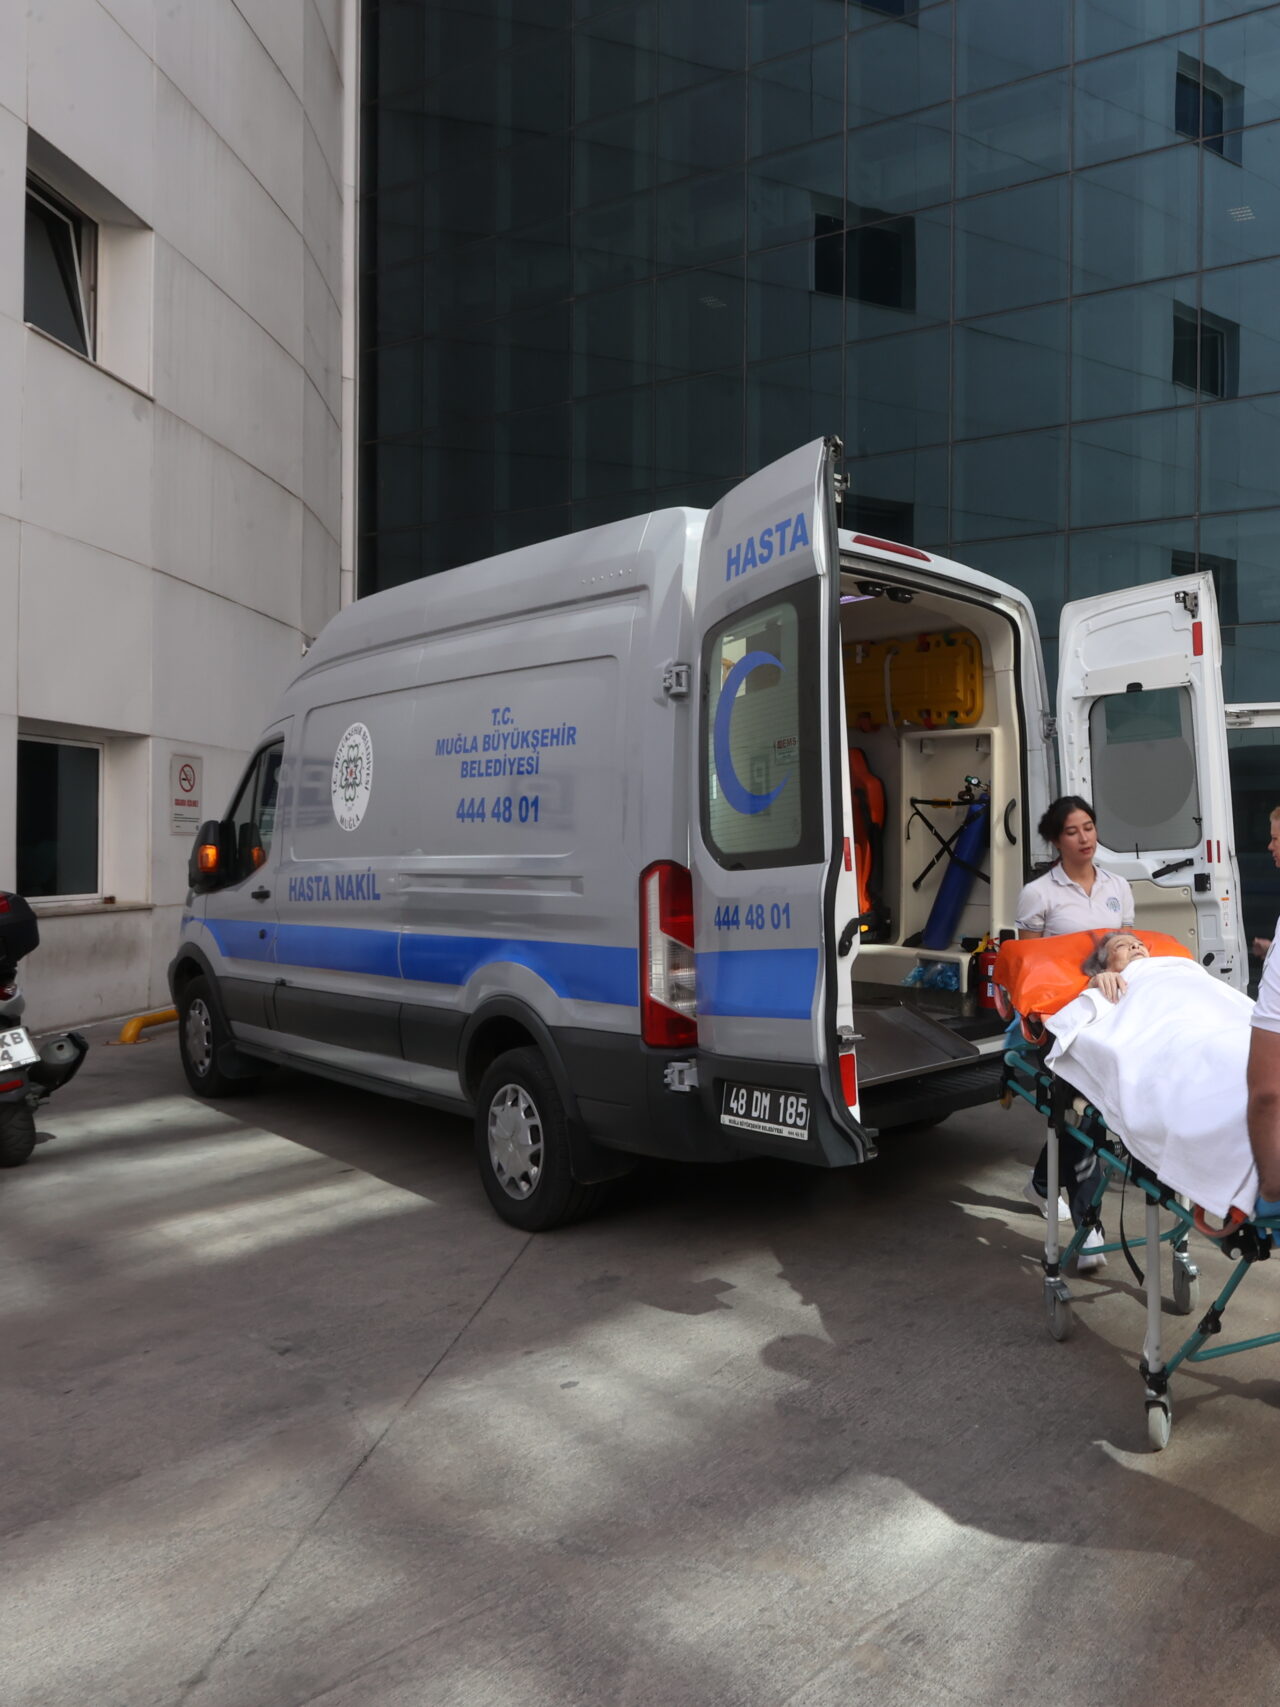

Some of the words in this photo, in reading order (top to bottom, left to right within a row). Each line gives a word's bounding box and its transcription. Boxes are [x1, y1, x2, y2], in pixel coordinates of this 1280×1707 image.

[726, 512, 809, 582] HASTA
[491, 707, 514, 726] T.C.
[435, 733, 478, 756] MUĞLA
[482, 722, 577, 753] BÜYÜKŞEHİR
[460, 751, 540, 778] BELEDİYESİ
[456, 797, 486, 823] 444
[491, 796, 513, 823] 48
[518, 795, 540, 823] 01
[289, 875, 331, 902] HASTA
[336, 866, 381, 901] NAKİL
[714, 904, 740, 931] 444
[745, 904, 765, 930] 48
[770, 902, 791, 929] 01
[729, 1087, 747, 1115] 48
[751, 1090, 771, 1120] DM
[779, 1095, 808, 1126] 185
